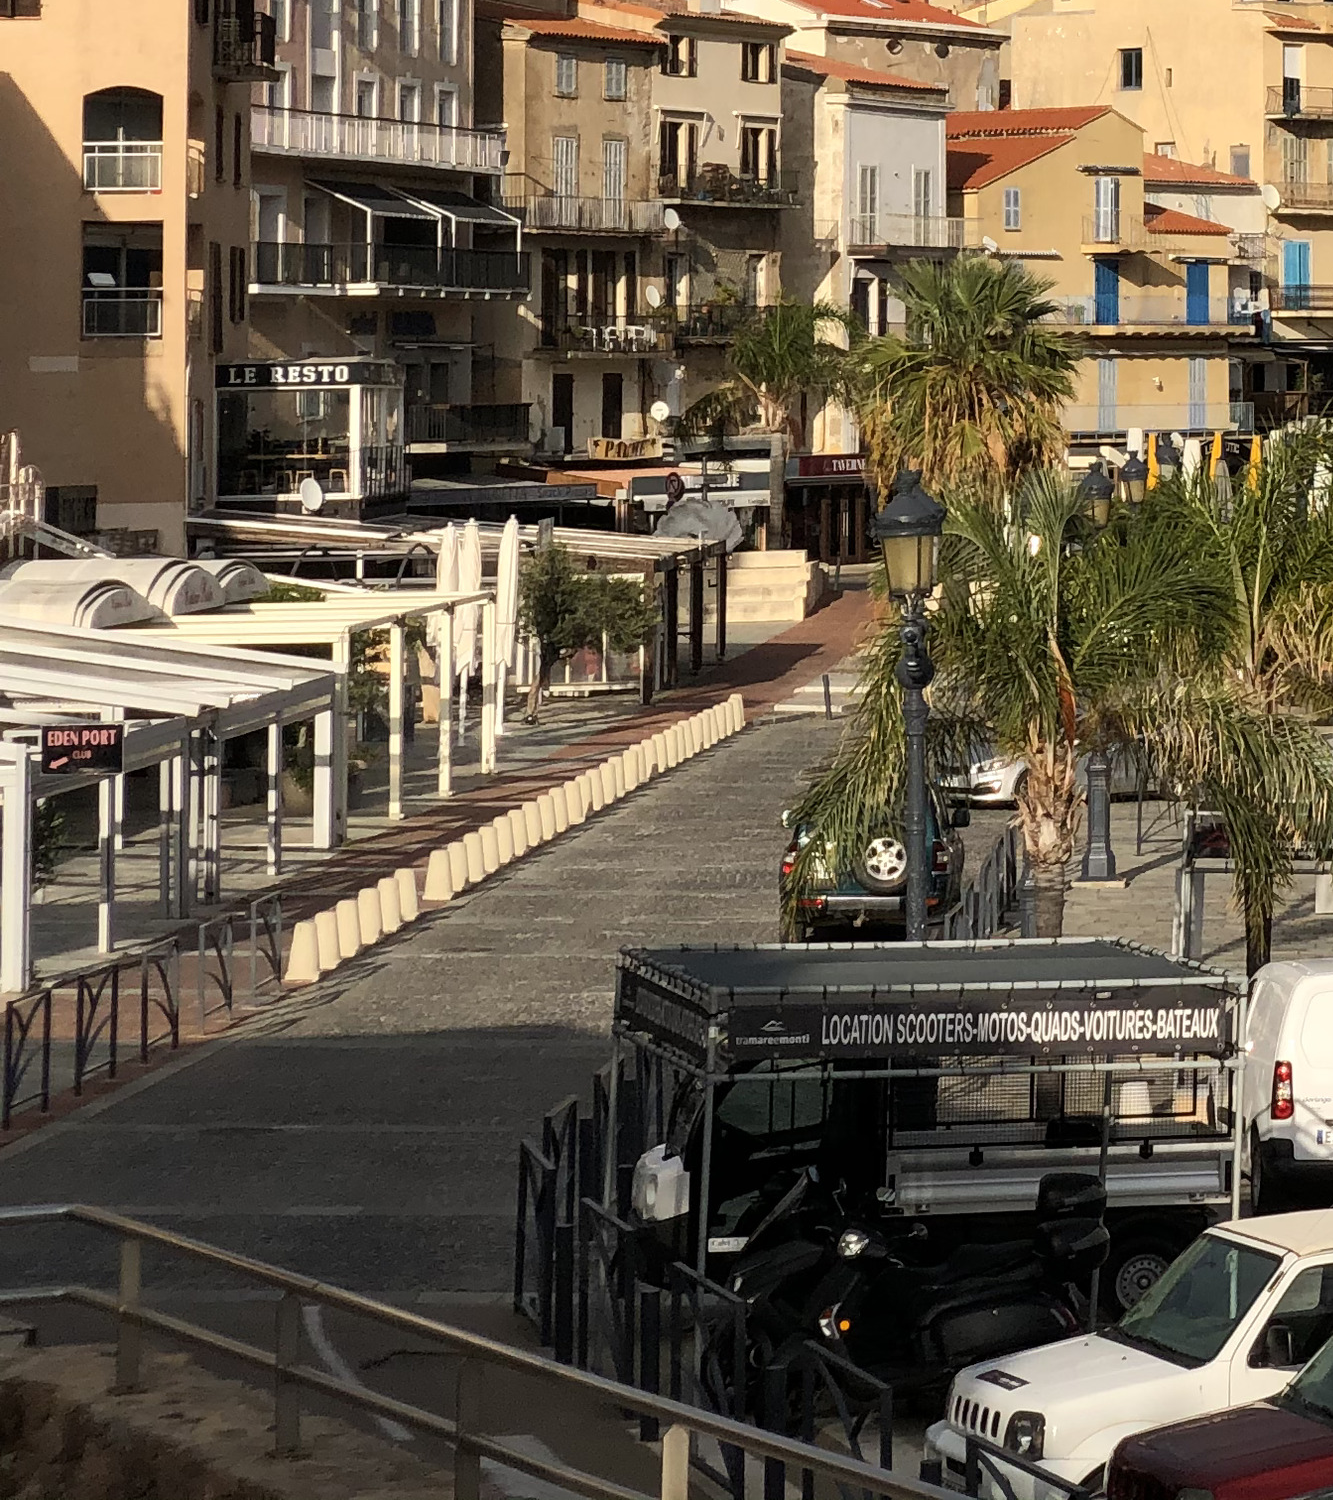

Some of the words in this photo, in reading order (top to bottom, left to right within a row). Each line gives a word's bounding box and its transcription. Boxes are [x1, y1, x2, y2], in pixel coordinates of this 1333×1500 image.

[228, 367, 257, 384] LE
[270, 365, 350, 383] RESTO
[47, 730, 79, 747] EDEN
[82, 729, 117, 746] PORT
[72, 750, 92, 760] CLUB
[821, 1014, 894, 1046] LOCATION
